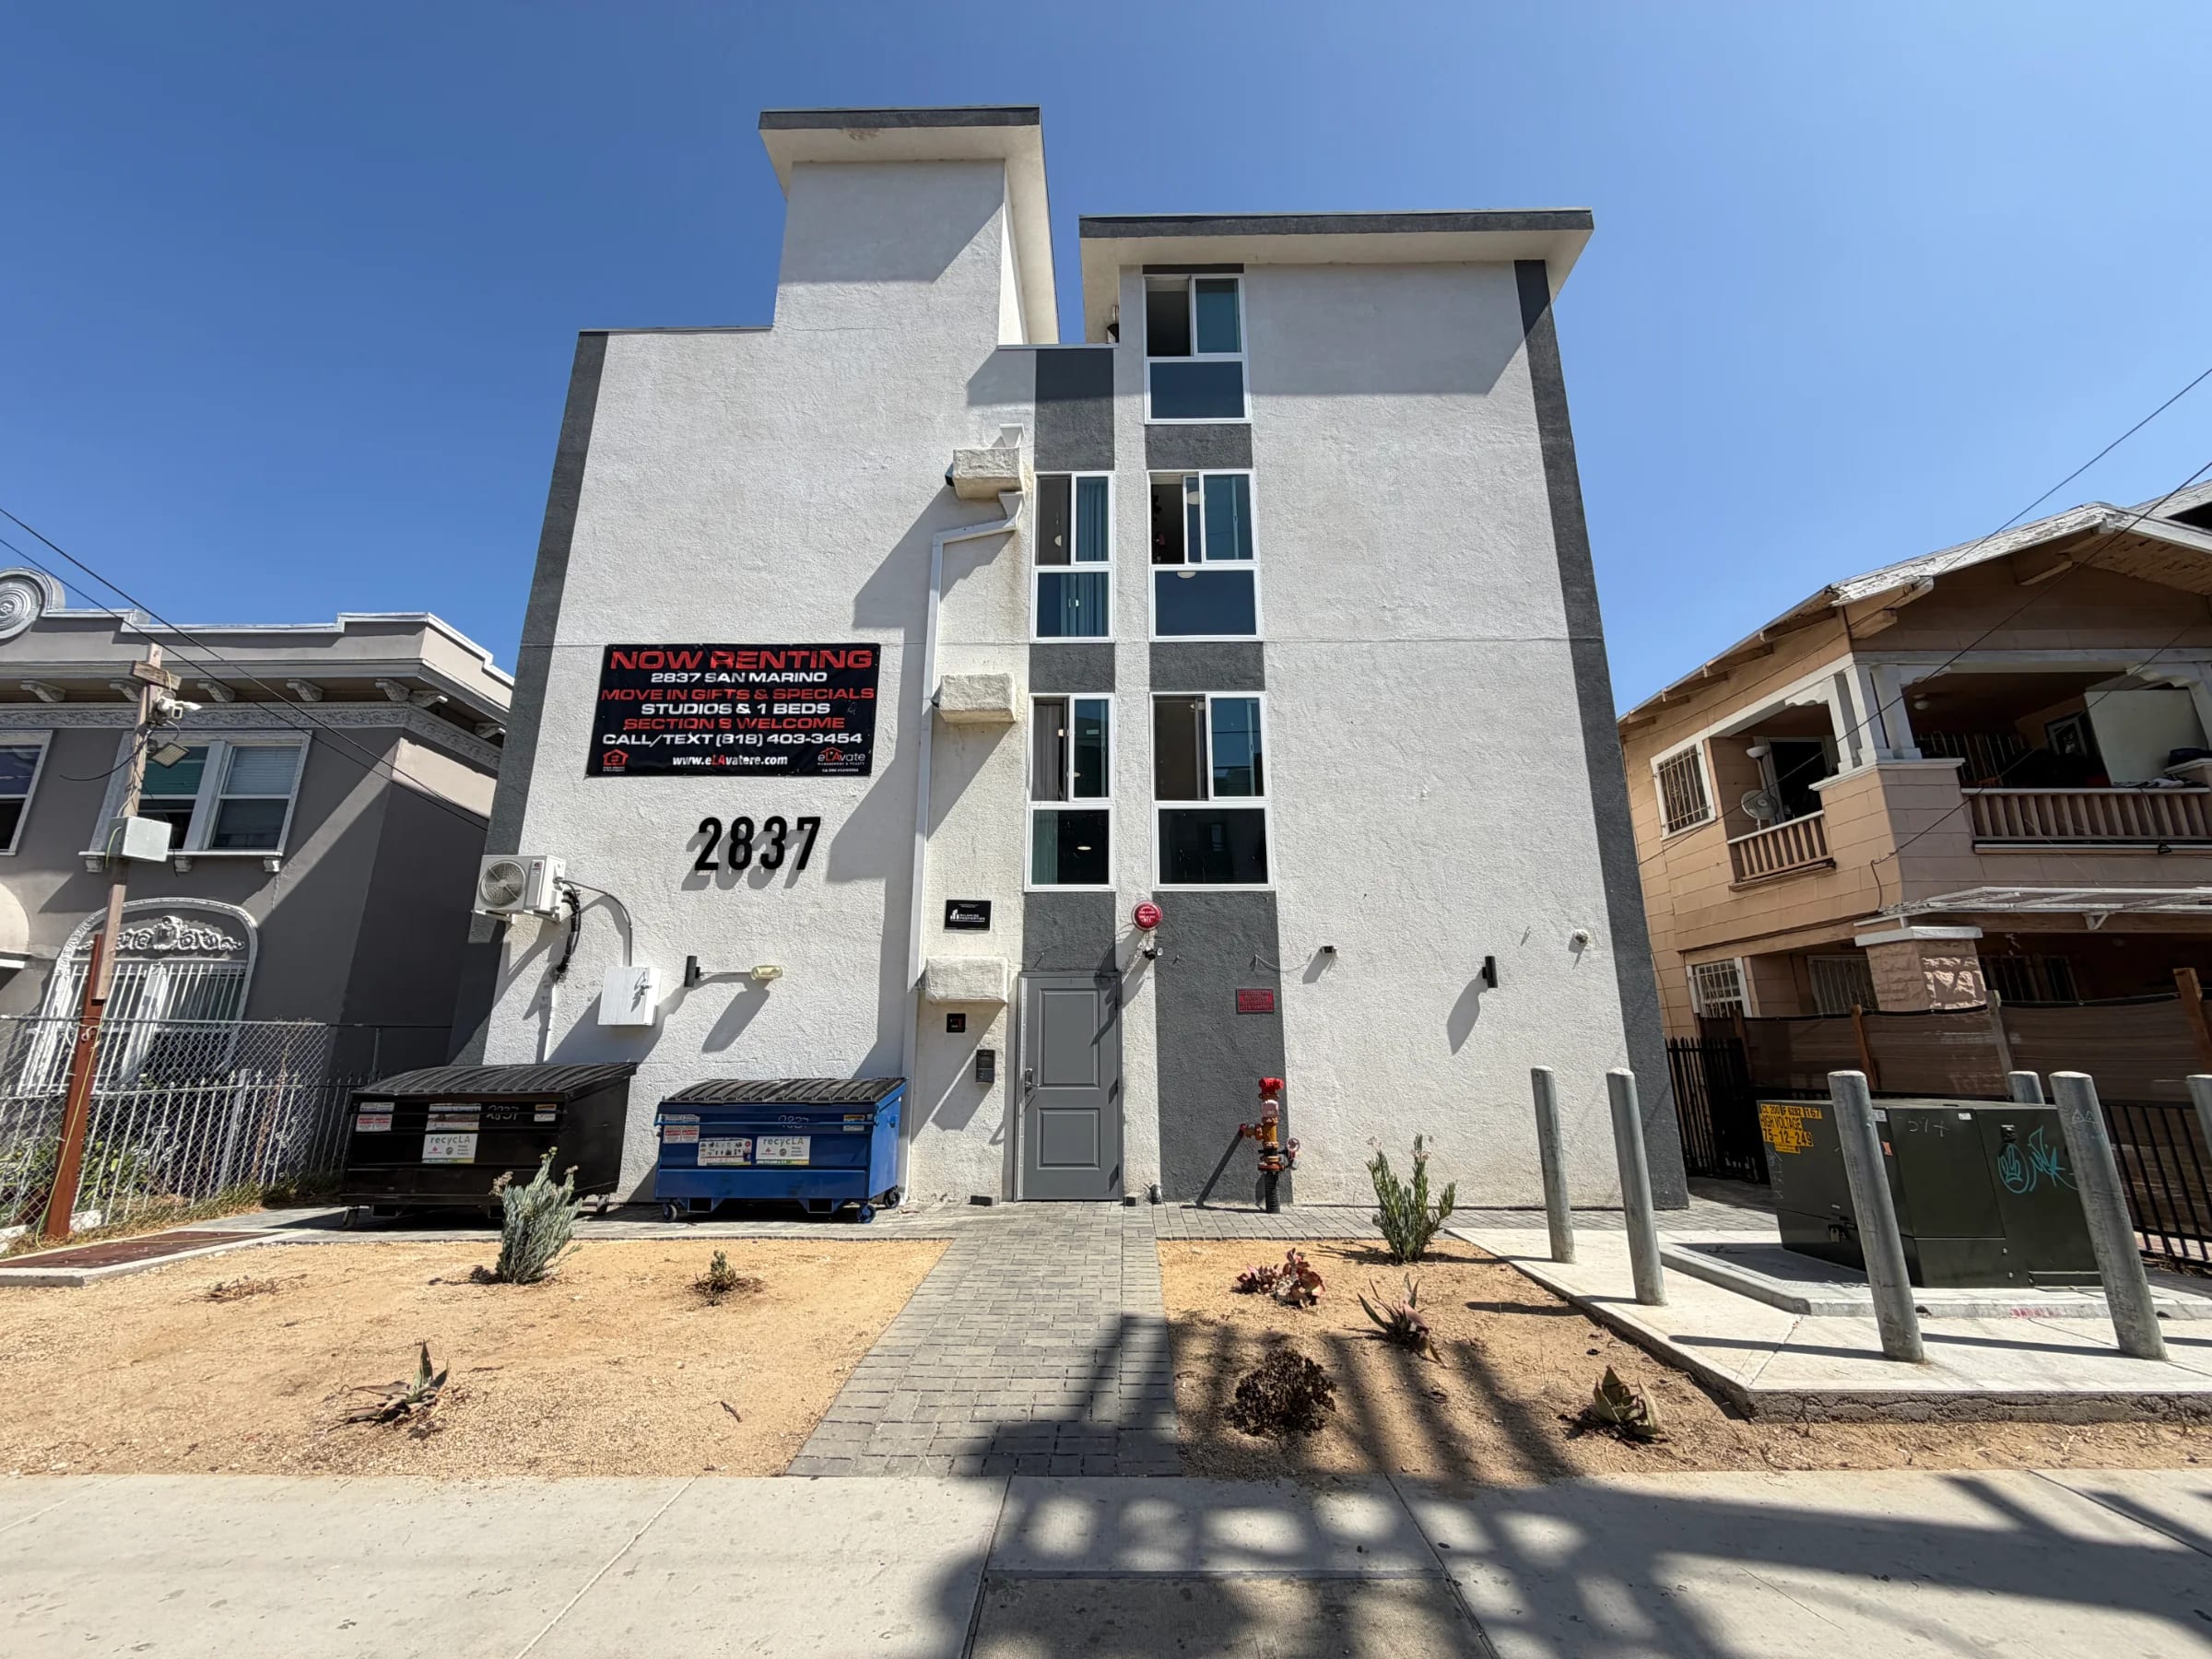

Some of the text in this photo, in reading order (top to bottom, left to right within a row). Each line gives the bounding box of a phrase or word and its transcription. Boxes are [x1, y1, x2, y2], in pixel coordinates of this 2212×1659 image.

[610, 650, 873, 669] NOW RENTING
[651, 672, 828, 683] 2837 SAN MARINO
[601, 688, 875, 700] MOVE IN GIFTS & SPECIALS
[641, 703, 831, 715] STUDIOS & 1 BEDS
[624, 717, 846, 730] SECTION 8 WELCOME
[602, 733, 863, 747] CALL/TEXT (818) 403-3454
[694, 816, 821, 870] 2837
[1806, 1109, 1820, 1118] 167
[1760, 1114, 1802, 1131] HIGH VOLTAGE
[763, 1136, 804, 1147] recycLA
[1763, 1128, 1812, 1145] 75-12-249
